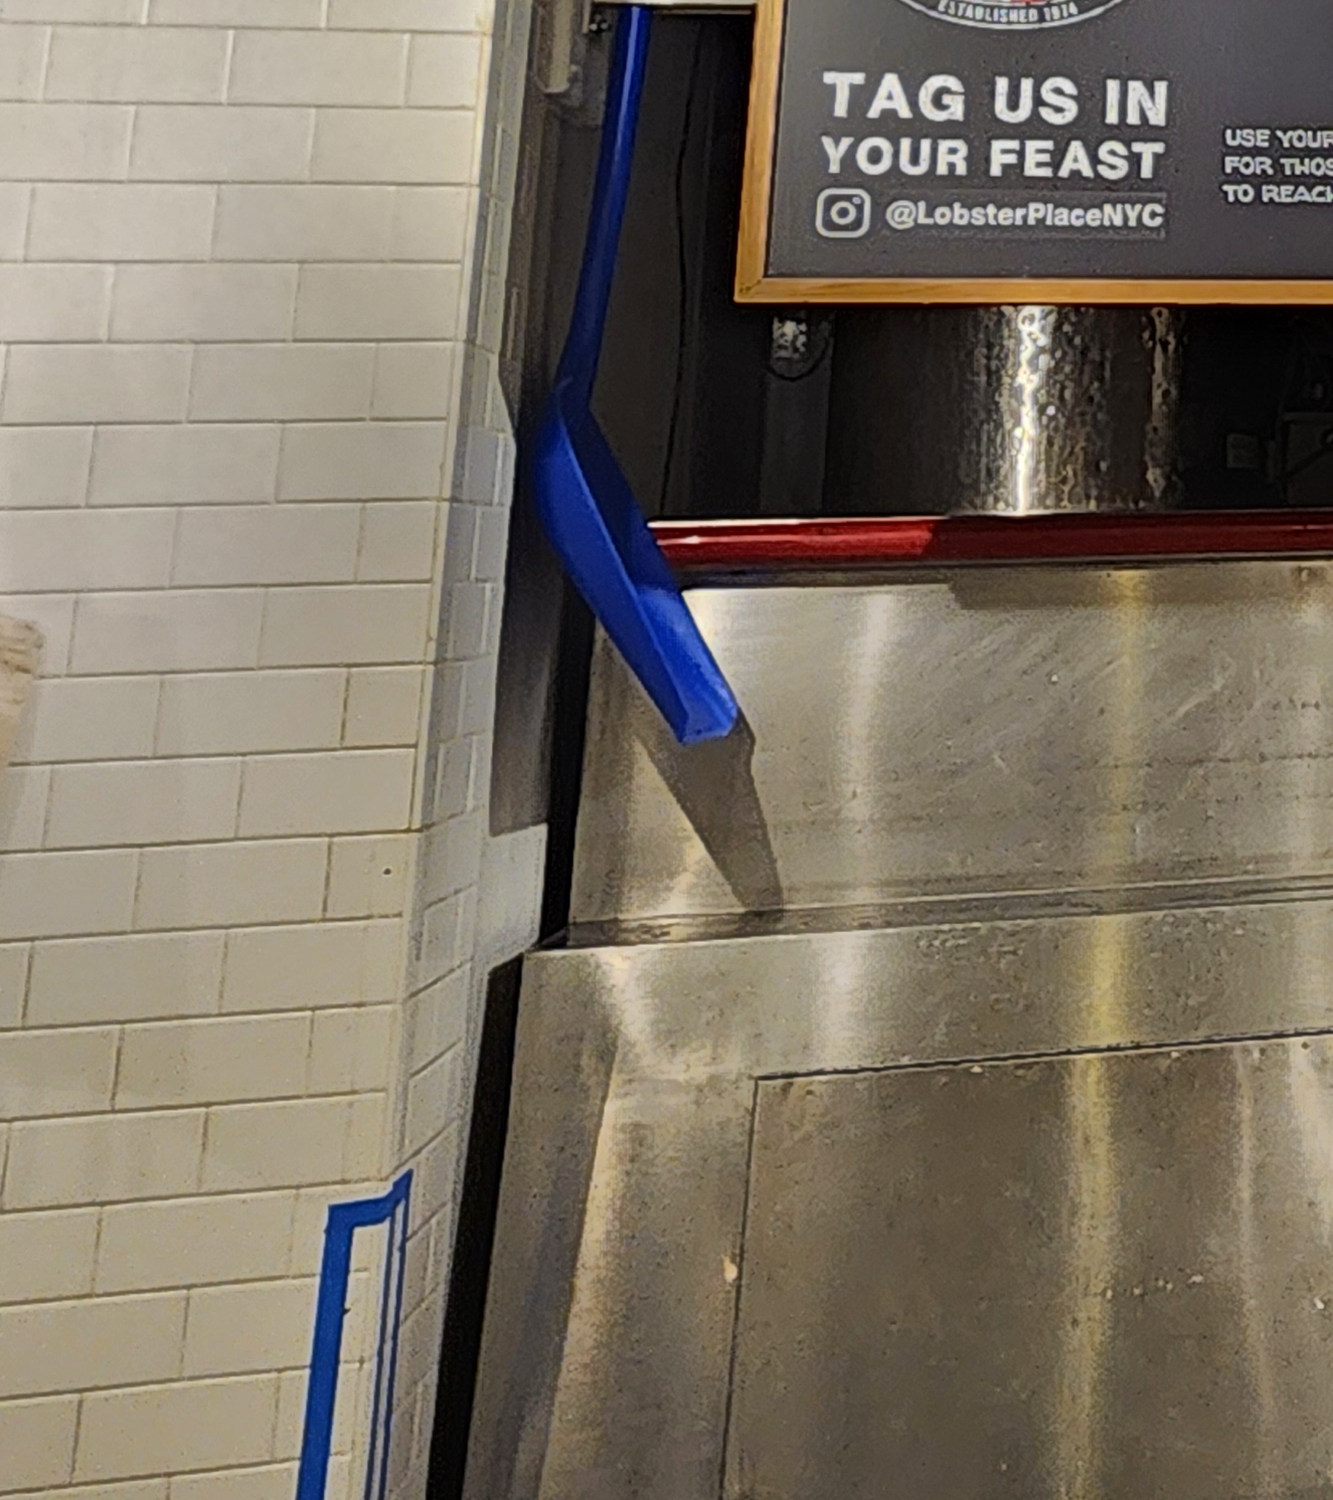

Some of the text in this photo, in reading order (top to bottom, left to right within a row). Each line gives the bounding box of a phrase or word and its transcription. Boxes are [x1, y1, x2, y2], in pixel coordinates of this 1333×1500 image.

[822, 70, 1169, 127] TAG US IN
[1225, 129, 1271, 148] USE
[821, 135, 1166, 180] YOUR FEAST
[1223, 156, 1275, 176] FOR
[1222, 183, 1257, 203] TO
[885, 200, 1166, 230] @LobsterPlaceNYC
